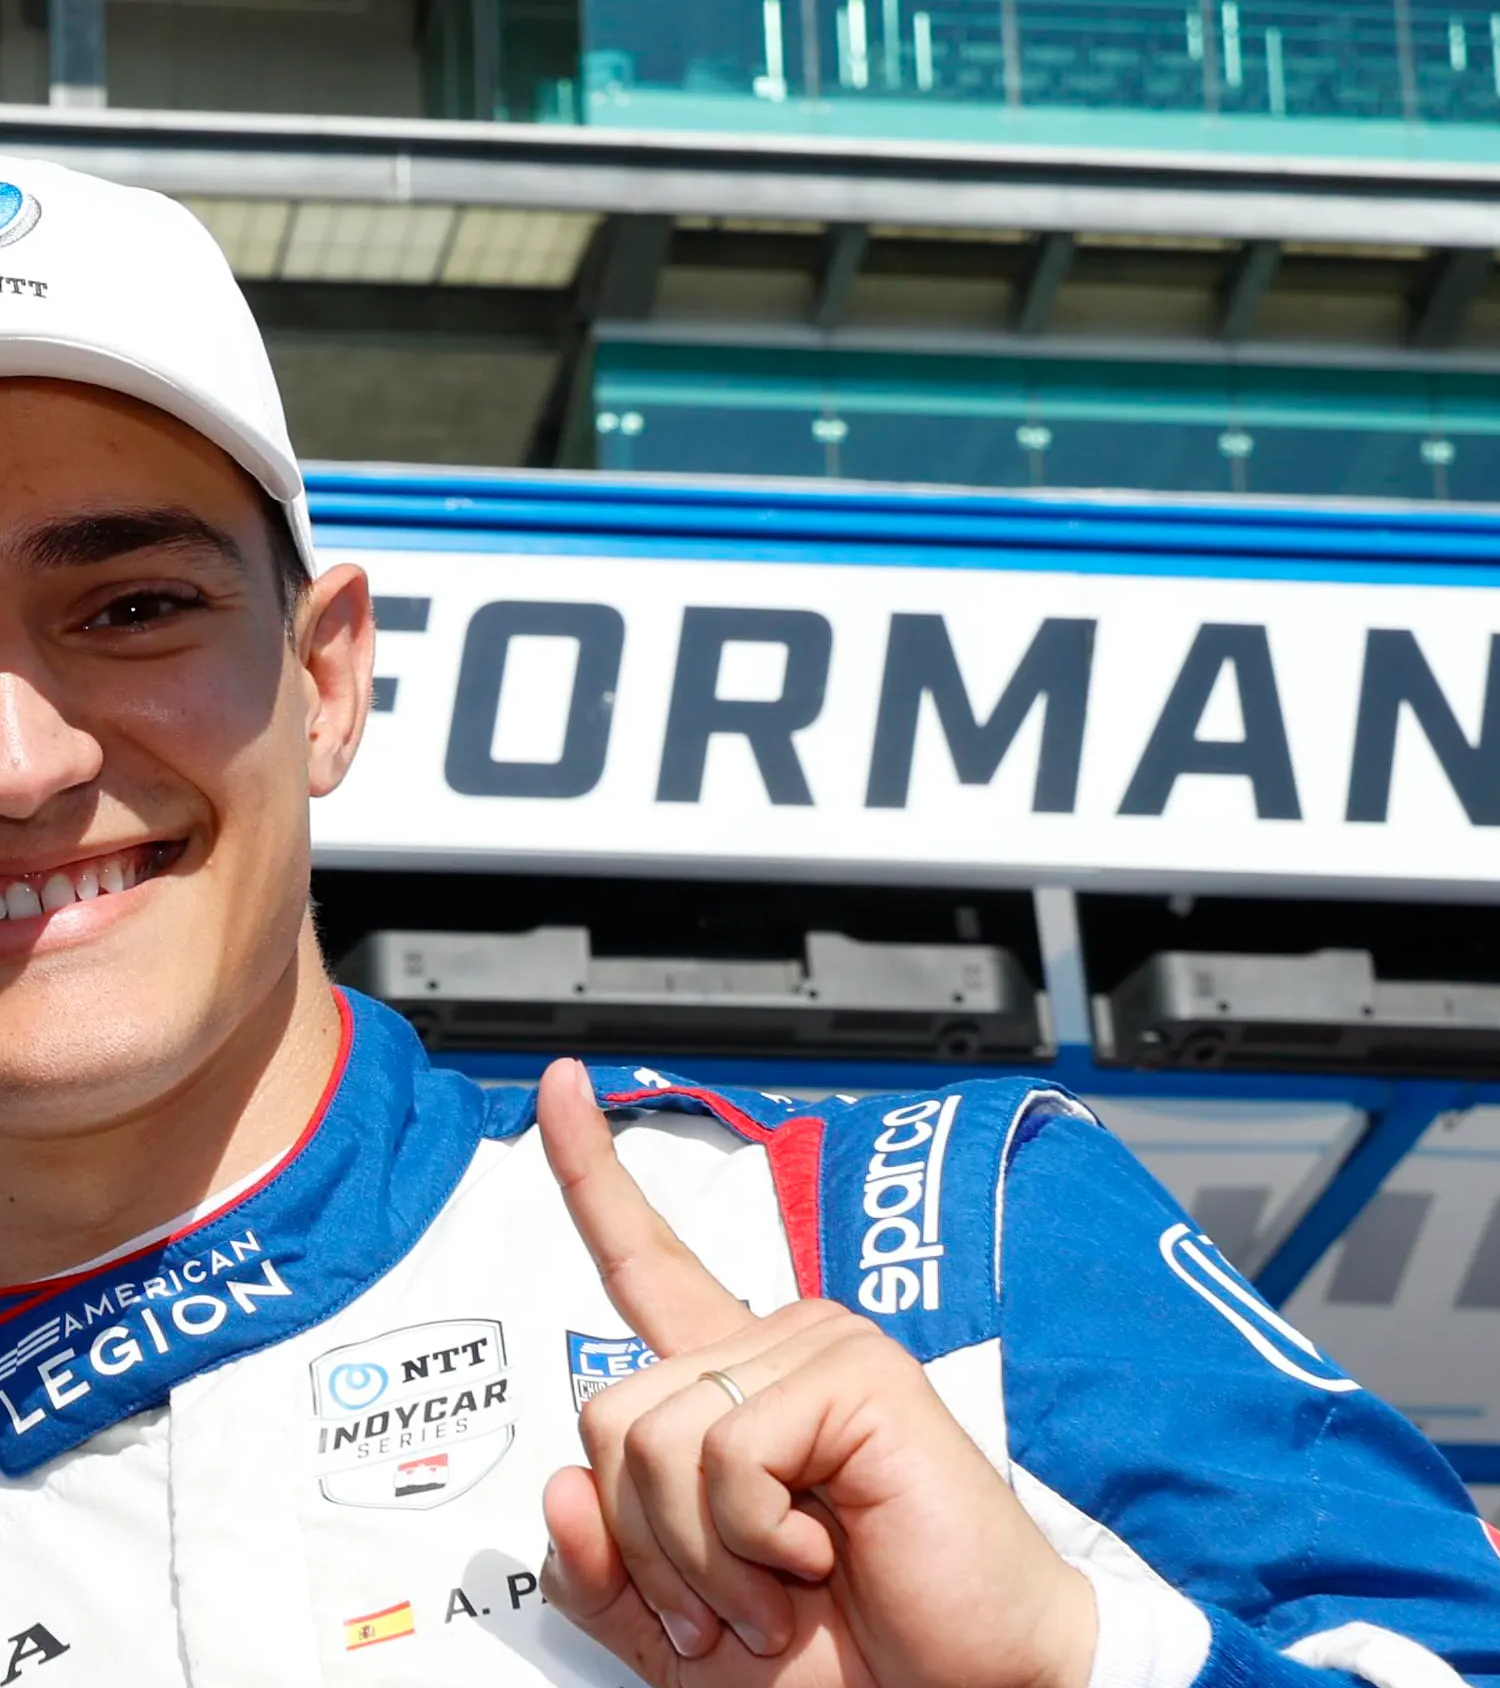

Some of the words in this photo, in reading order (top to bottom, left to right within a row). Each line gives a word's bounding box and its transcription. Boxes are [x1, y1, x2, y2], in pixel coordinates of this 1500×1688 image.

[858, 1100, 945, 1314] sparco
[62, 1231, 262, 1338] AMERICAN
[402, 1338, 488, 1383] NTT
[579, 1350, 661, 1377] LEG
[317, 1379, 509, 1454] INDYCAR
[357, 1417, 469, 1459] SERIES
[444, 1588, 490, 1624] A.
